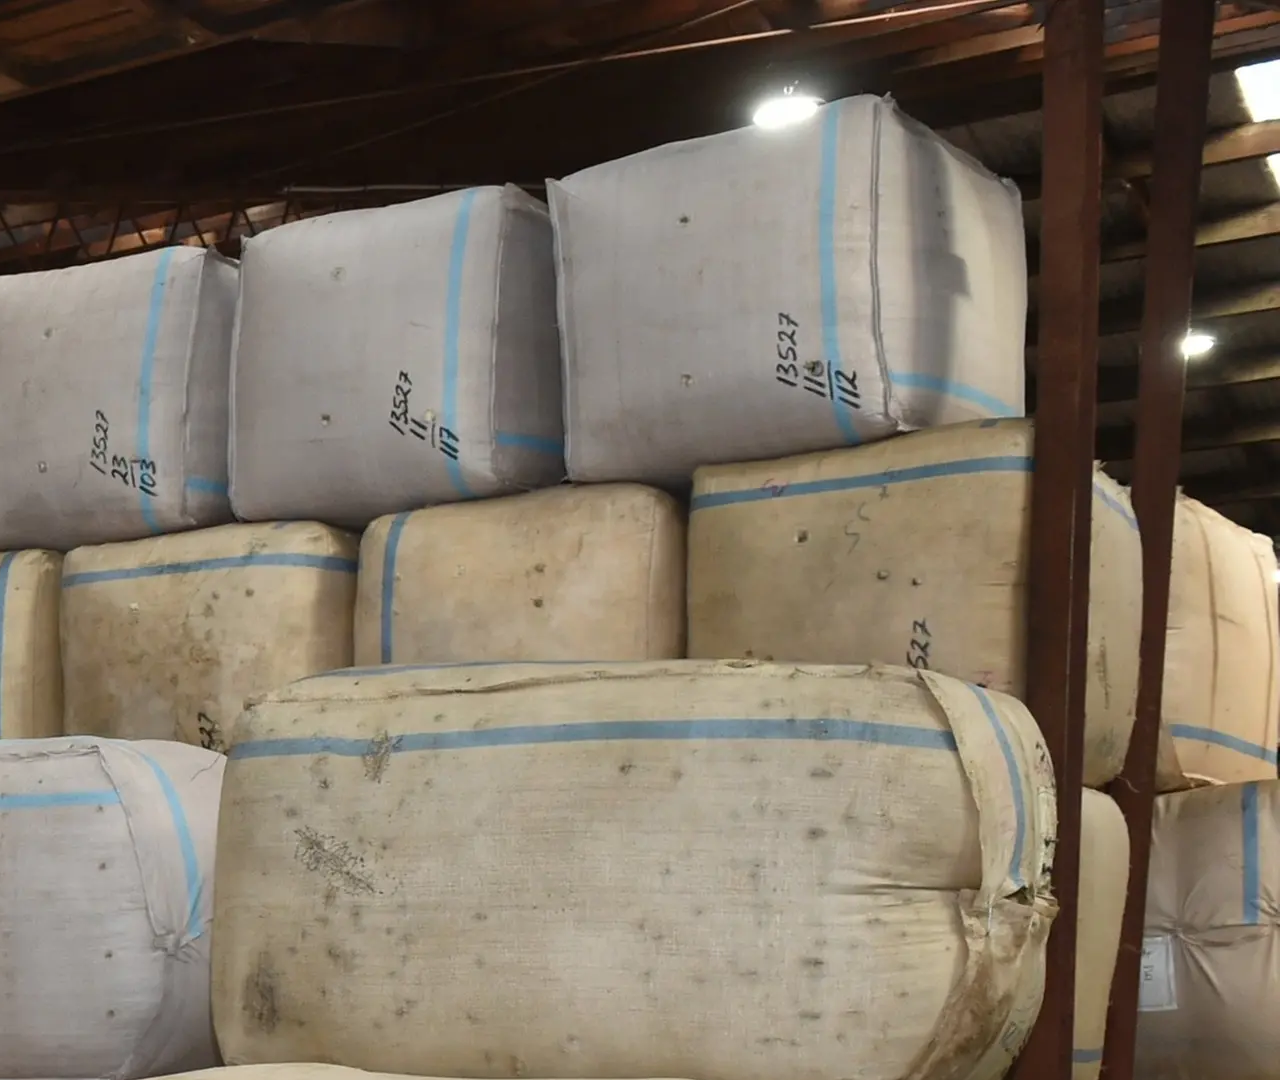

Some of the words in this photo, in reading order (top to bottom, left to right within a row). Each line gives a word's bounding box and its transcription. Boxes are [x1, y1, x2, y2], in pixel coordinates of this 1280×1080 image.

[776, 312, 799, 387] 13527
[388, 370, 412, 436] 13527
[834, 370, 862, 409] 112
[89, 409, 109, 476] 13527
[439, 426, 460, 460] 117
[110, 454, 130, 486] 23
[139, 458, 159, 497] 103
